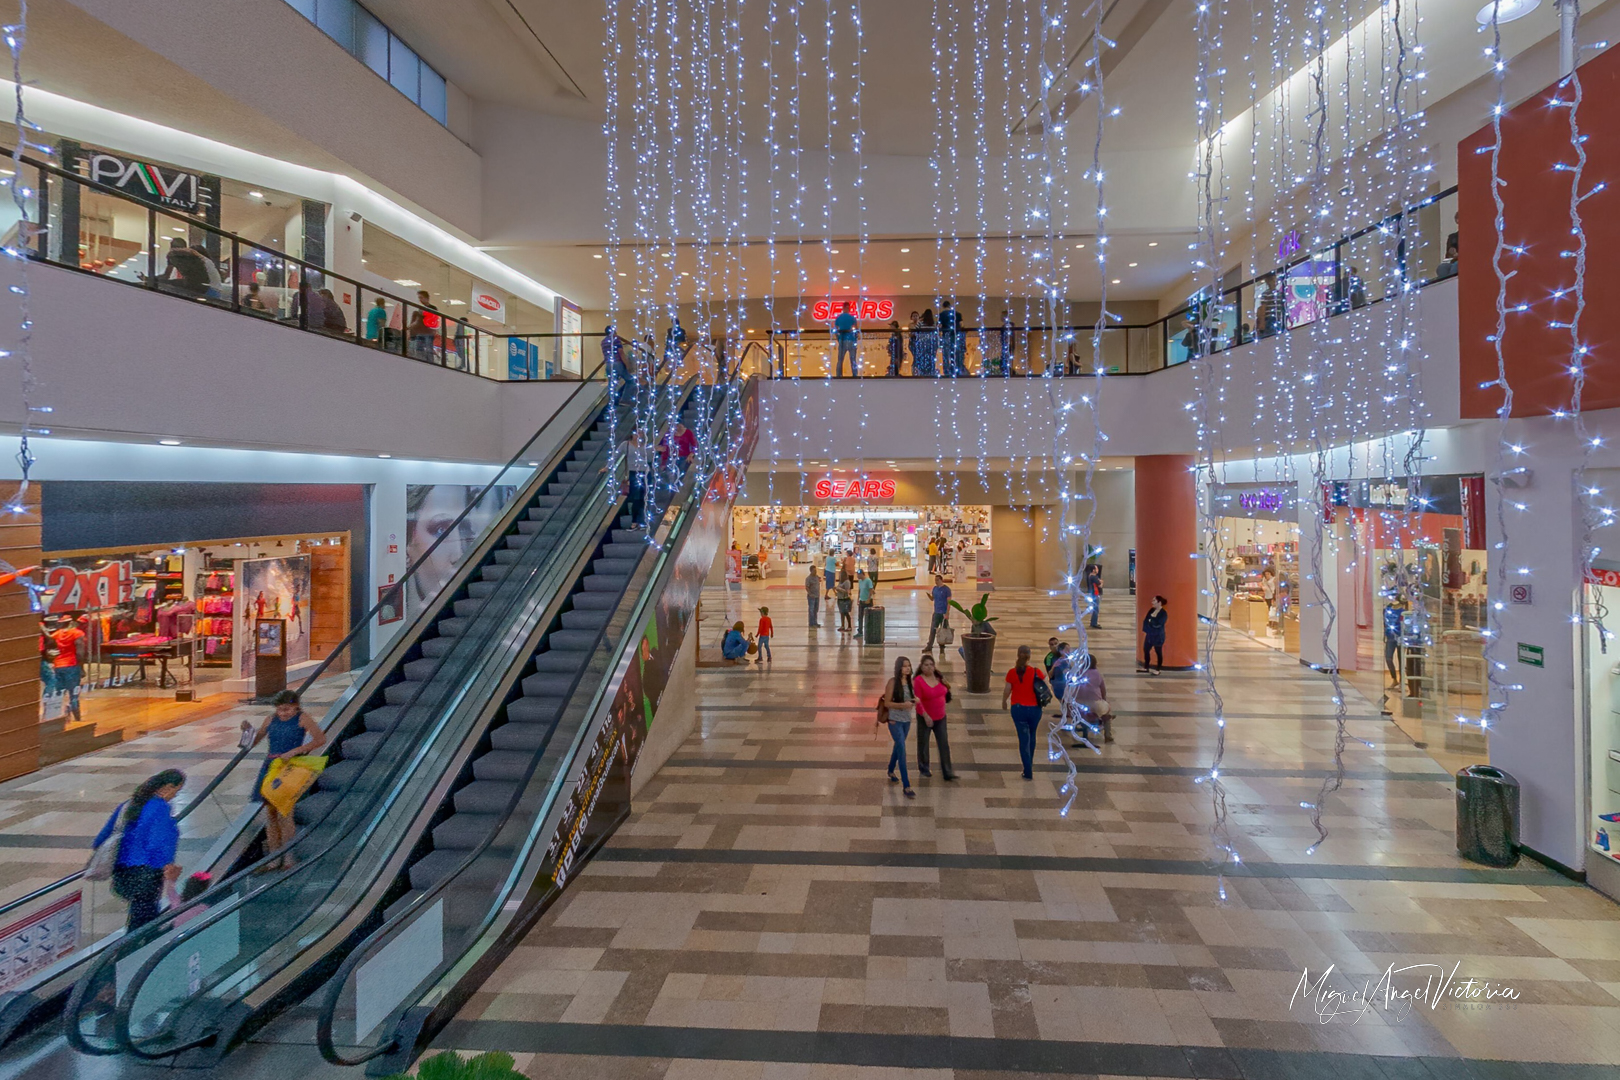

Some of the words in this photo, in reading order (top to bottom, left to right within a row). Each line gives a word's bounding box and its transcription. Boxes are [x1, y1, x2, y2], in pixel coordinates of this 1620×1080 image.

[92, 154, 197, 203] PAVI
[160, 196, 196, 209] ITALY
[812, 300, 895, 321] SEARS
[815, 479, 897, 499] SEARS
[104, 673, 134, 688] HERE
[551, 728, 618, 882] www.tvpacifico.com.mx
